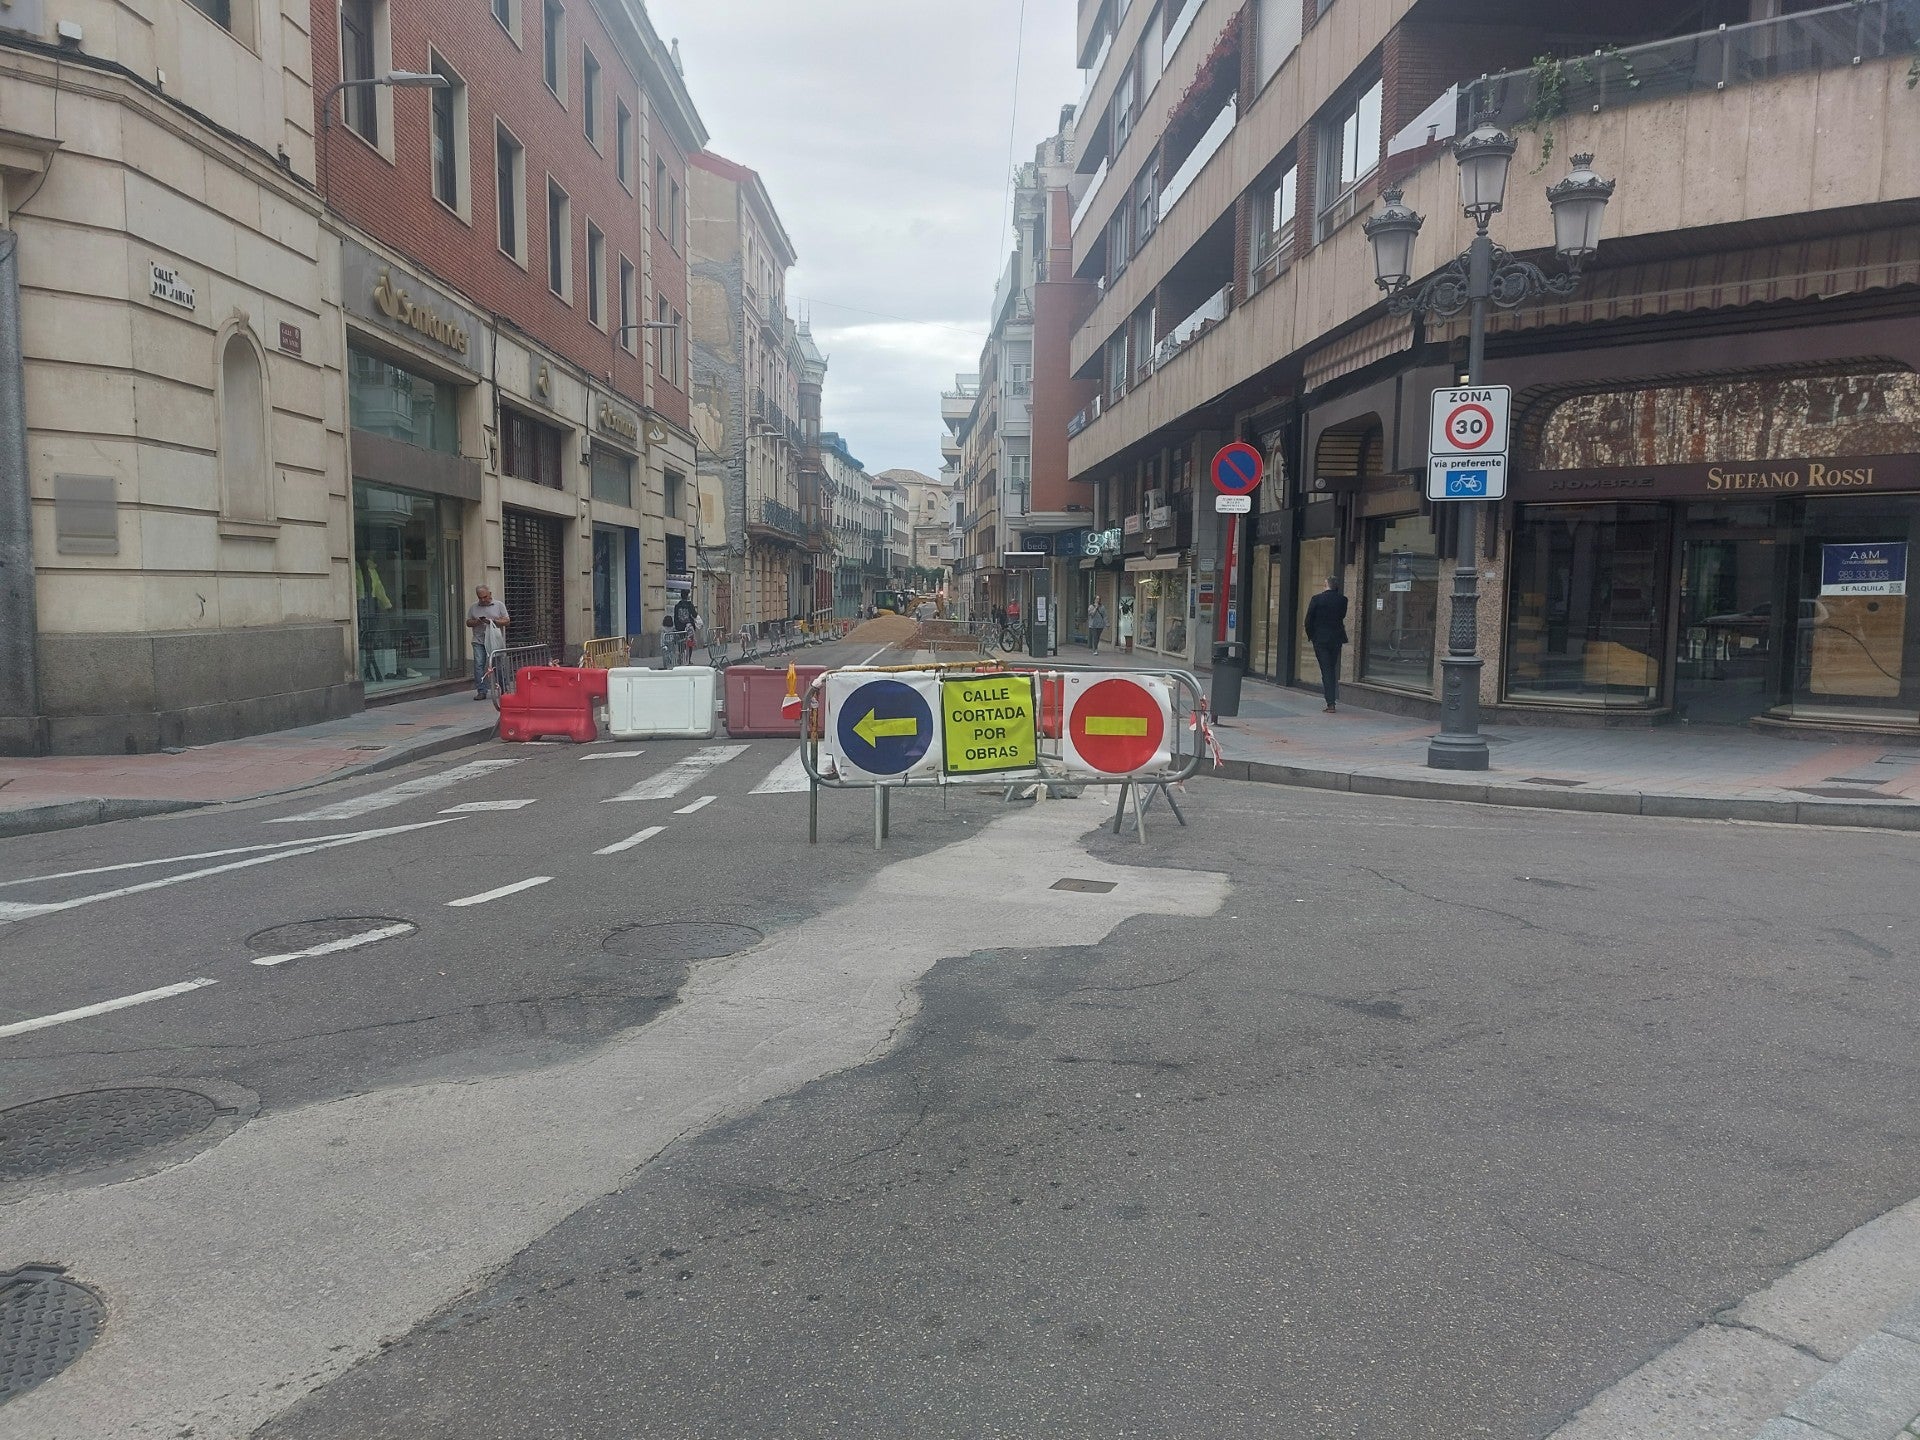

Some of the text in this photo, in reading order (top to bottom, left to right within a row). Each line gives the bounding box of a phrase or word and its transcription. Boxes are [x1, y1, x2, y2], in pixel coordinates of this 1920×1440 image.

[154, 267, 173, 284] CALLE
[1449, 391, 1492, 402] ZONA
[1455, 419, 1483, 435] 30
[1451, 459, 1502, 469] preferente
[1550, 477, 1654, 490] HOMBRE
[1027, 541, 1048, 550] beds
[963, 688, 1010, 703] CALLE
[952, 706, 1026, 723] CORTADA
[974, 727, 1006, 741] POR
[965, 745, 1019, 761] OBRAS
